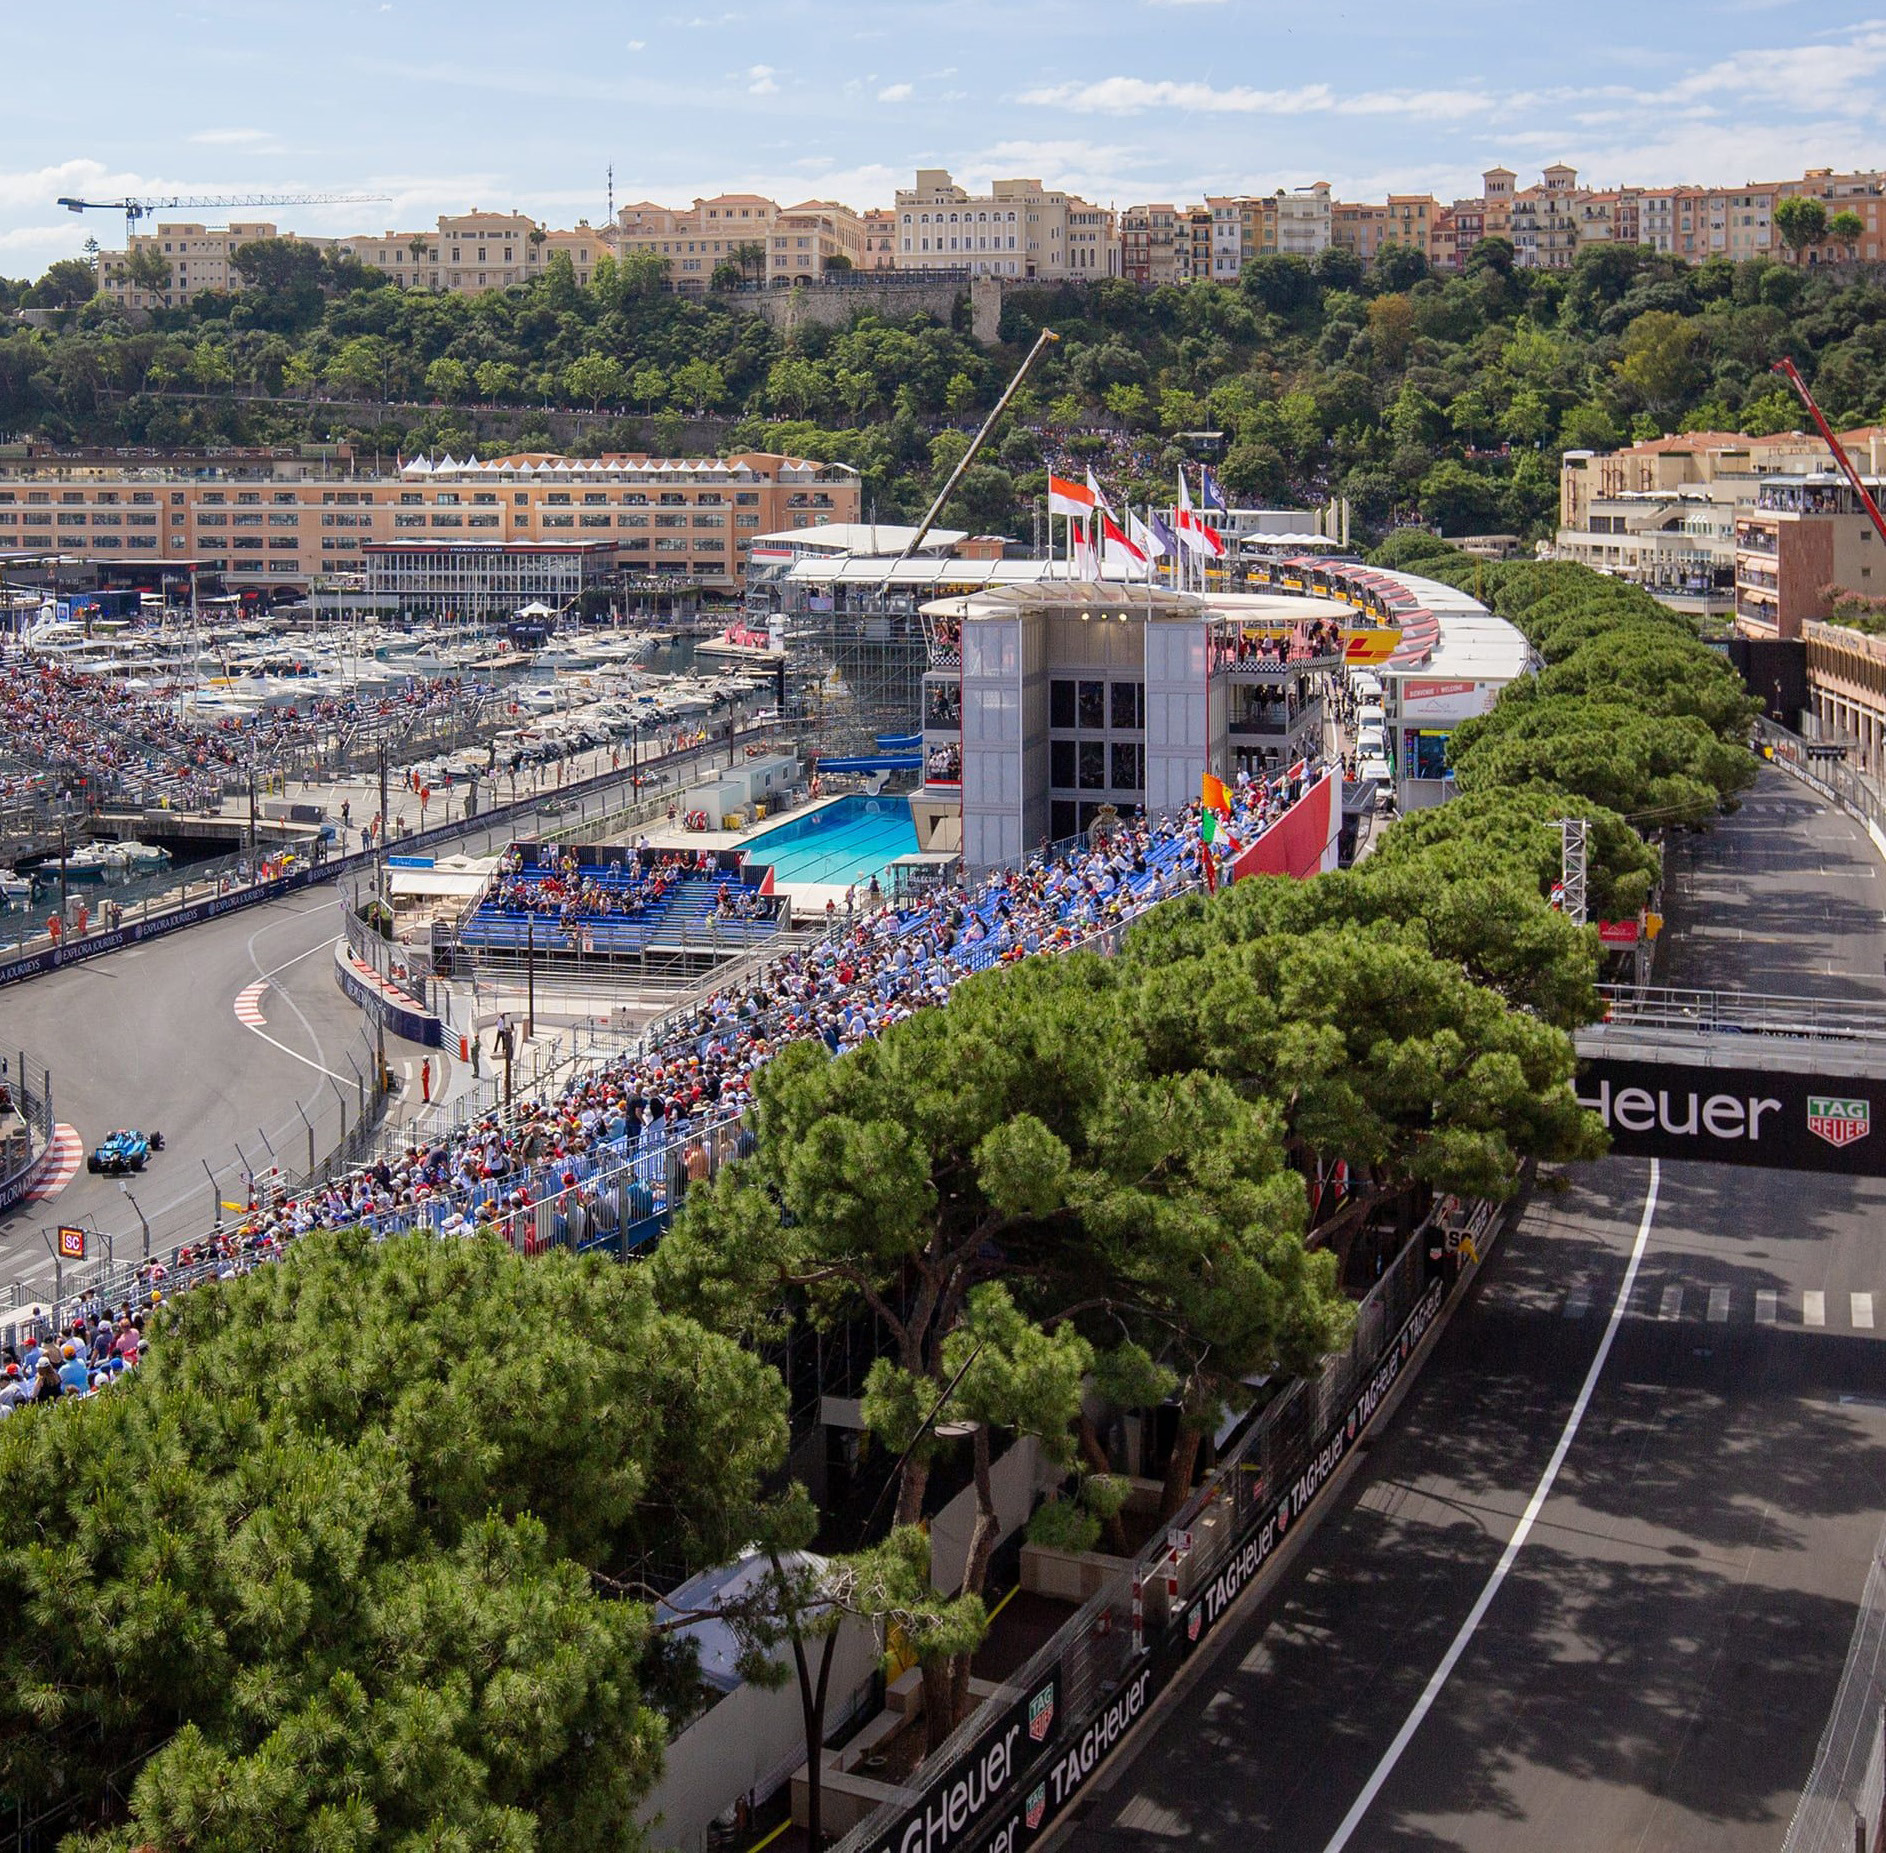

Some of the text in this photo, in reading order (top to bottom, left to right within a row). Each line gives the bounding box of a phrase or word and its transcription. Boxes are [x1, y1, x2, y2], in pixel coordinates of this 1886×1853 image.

[282, 866, 294, 875] SC
[143, 916, 170, 935] EXPLORA
[62, 943, 92, 961] EXPLORA
[7, 958, 41, 979] JOURNEYS
[1812, 1100, 1864, 1118] TAG
[1811, 1118, 1867, 1143] HEUER
[65, 1235, 80, 1250] SC
[1291, 1426, 1346, 1516] TAGHeuer
[1205, 1516, 1277, 1622] TAGHeuer
[1031, 1685, 1053, 1713] TAG
[1051, 1670, 1150, 1804] TAGHeuer
